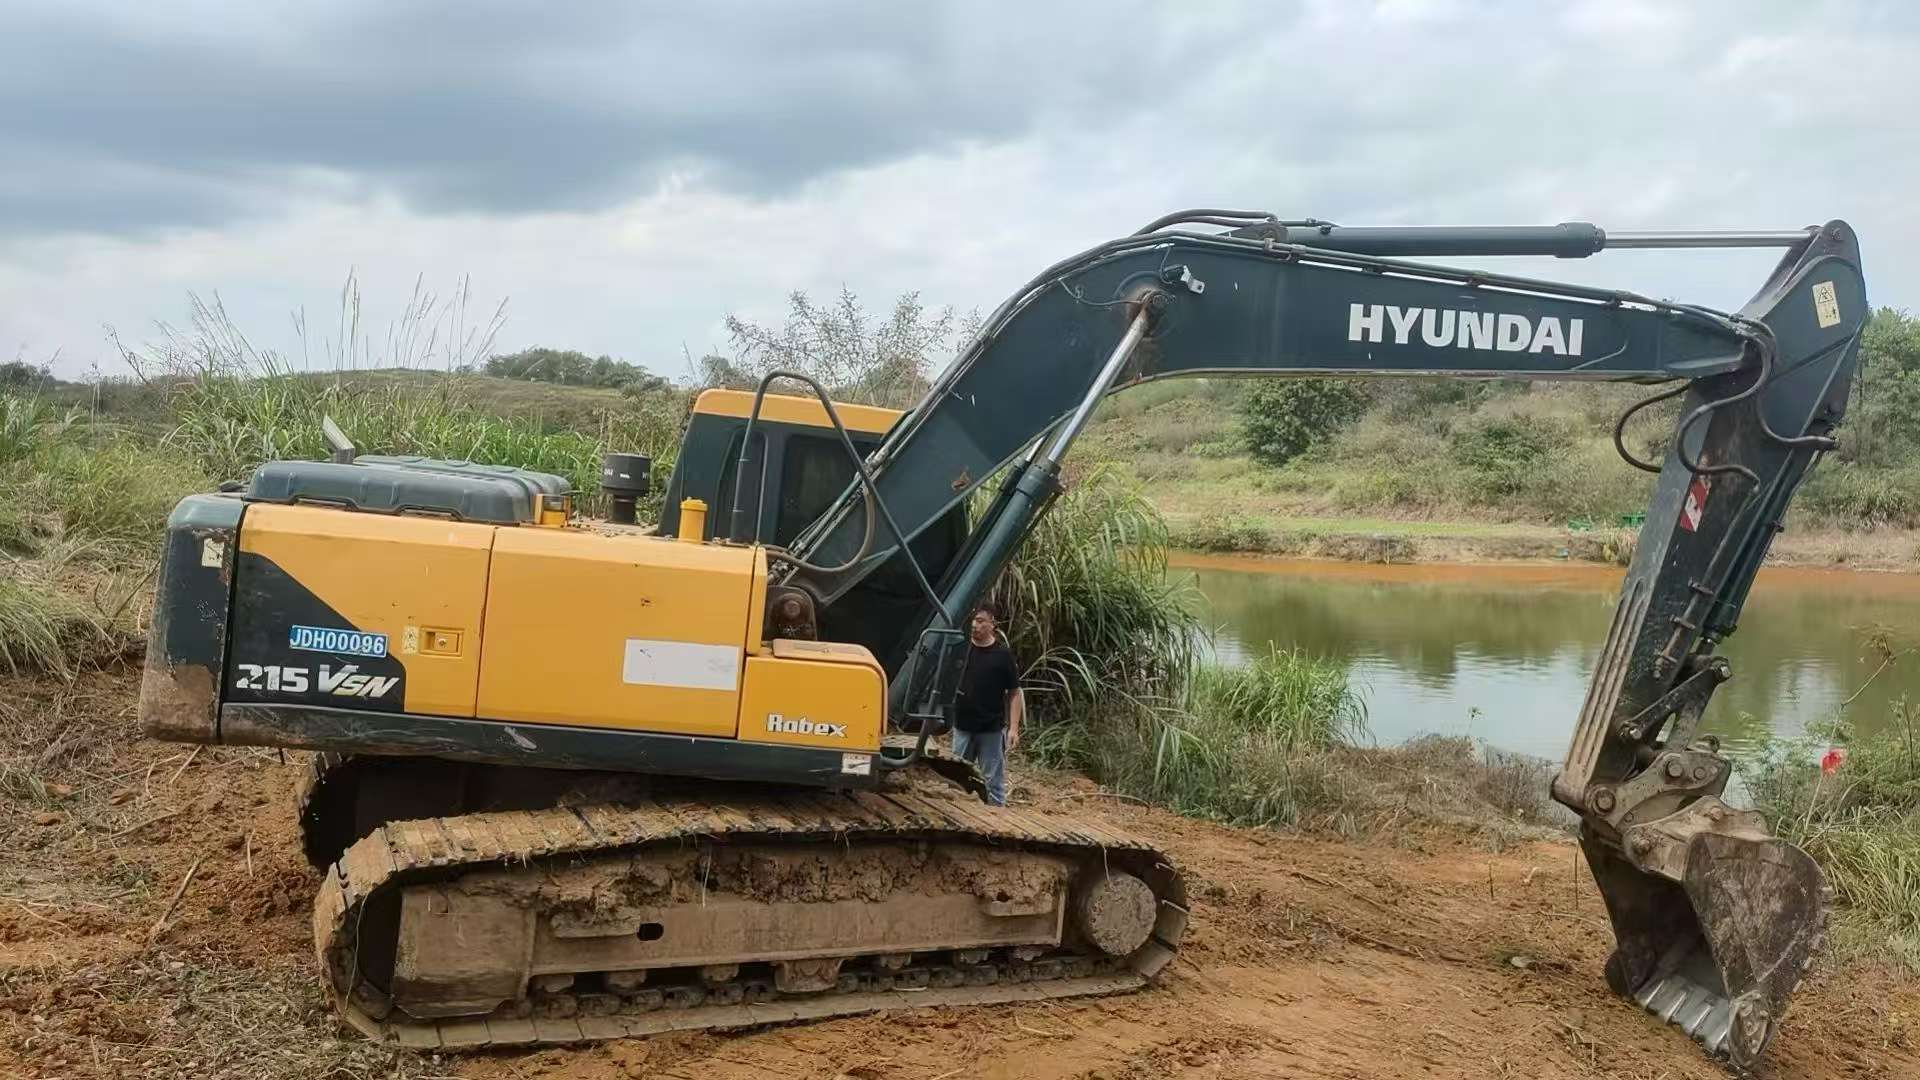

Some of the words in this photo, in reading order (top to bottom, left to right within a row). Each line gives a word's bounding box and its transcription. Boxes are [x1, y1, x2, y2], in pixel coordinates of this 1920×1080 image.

[1348, 303, 1584, 356] HYUNDAI
[289, 627, 385, 654] JDH00096
[236, 664, 309, 692] 215
[767, 713, 848, 738] Robex
